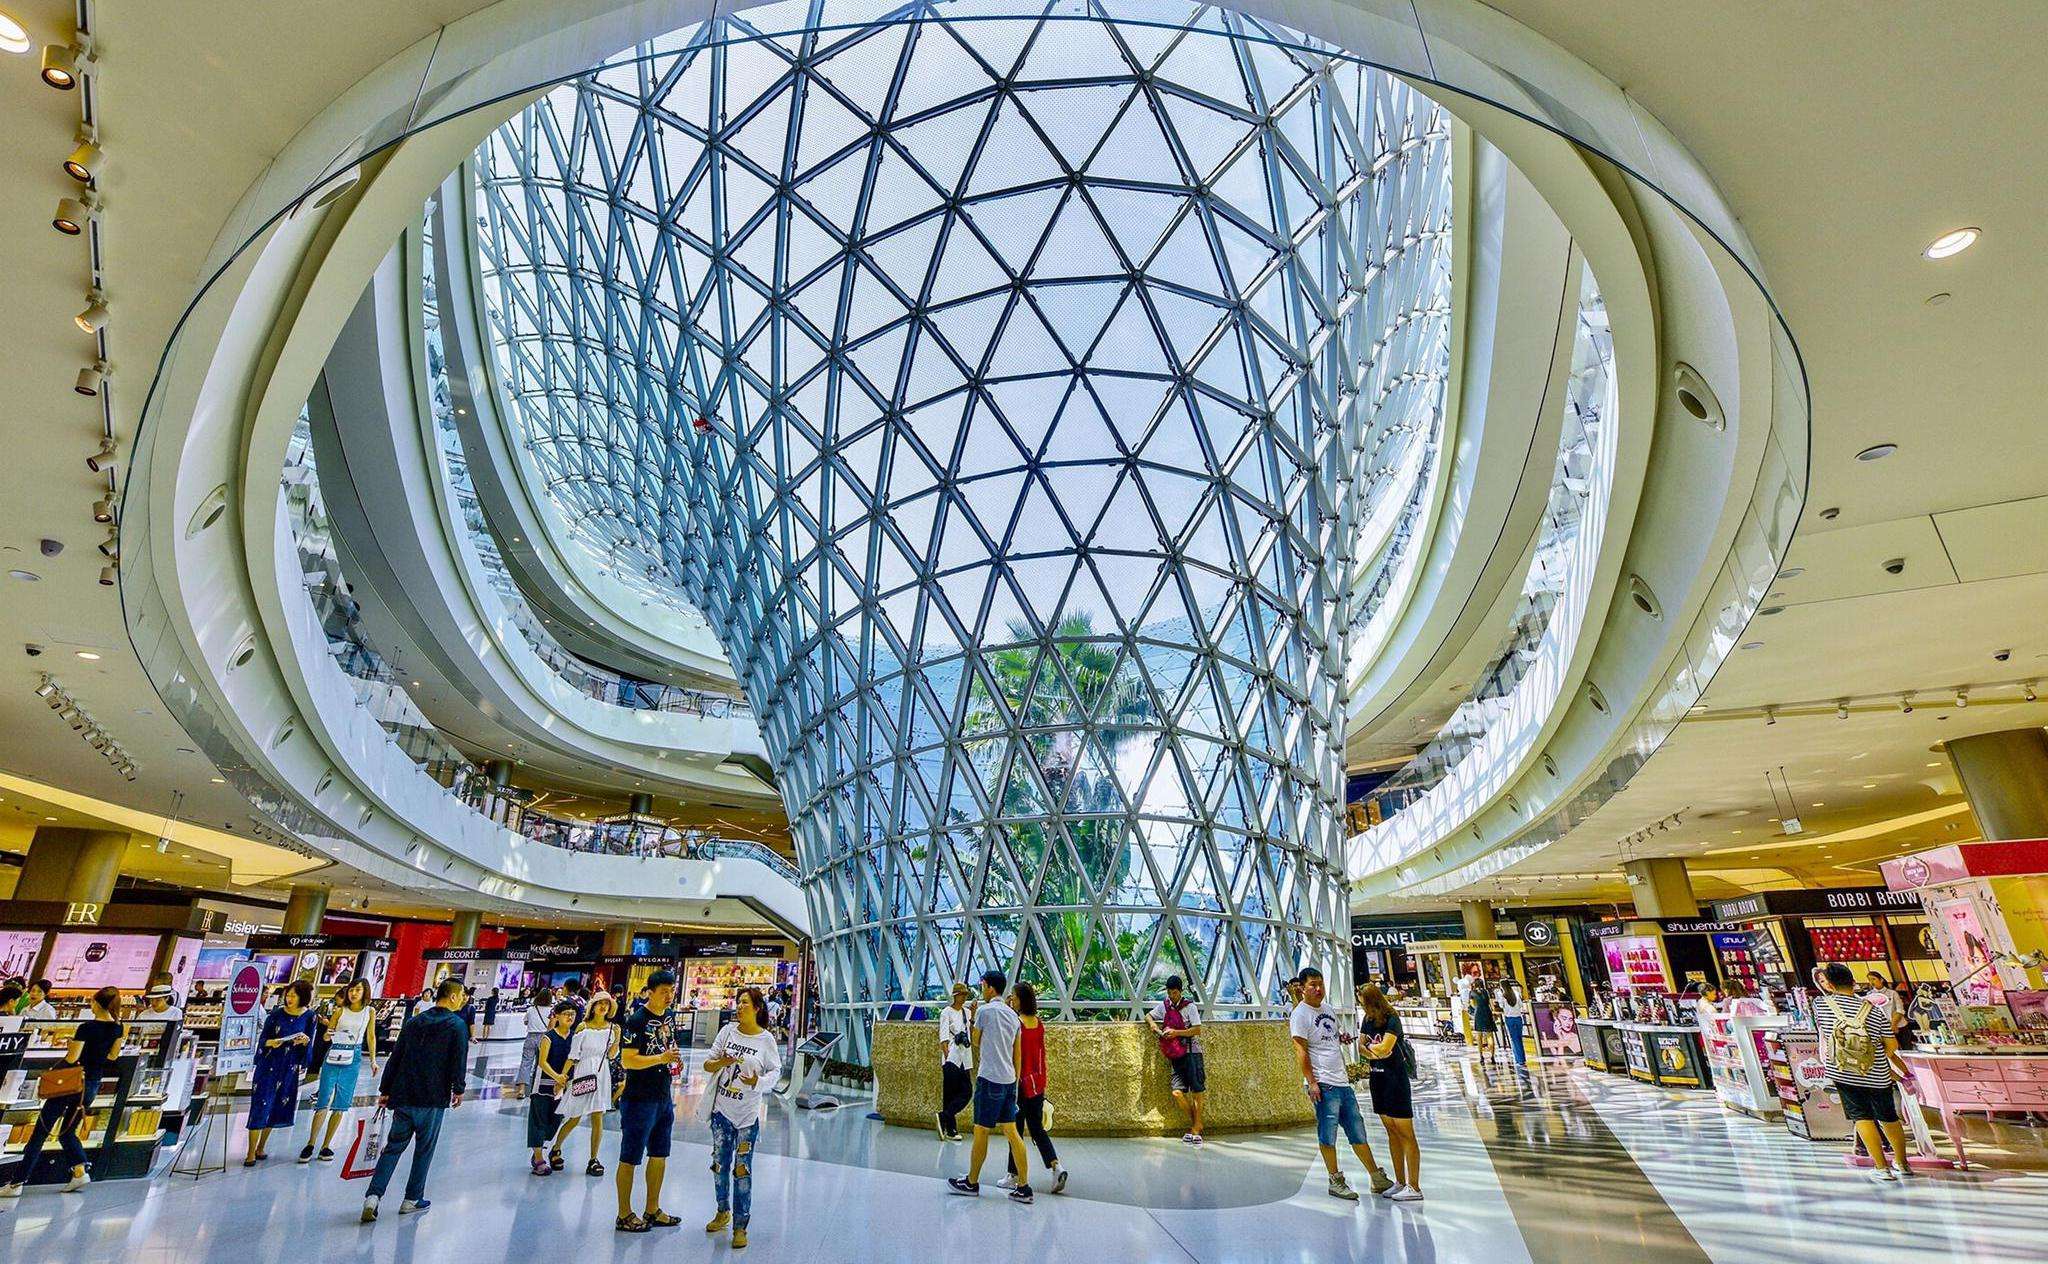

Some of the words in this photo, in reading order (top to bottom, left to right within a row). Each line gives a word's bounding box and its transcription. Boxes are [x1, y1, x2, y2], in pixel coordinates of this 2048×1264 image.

[1827, 893, 1872, 907] BOBBI
[1879, 887, 1918, 905] BROW
[66, 902, 97, 923] HR
[201, 910, 214, 929] HR
[224, 919, 259, 934] sisley
[1667, 919, 1688, 931] shu
[1691, 921, 1735, 931] uemura
[726, 1041, 758, 1056] LOONEY
